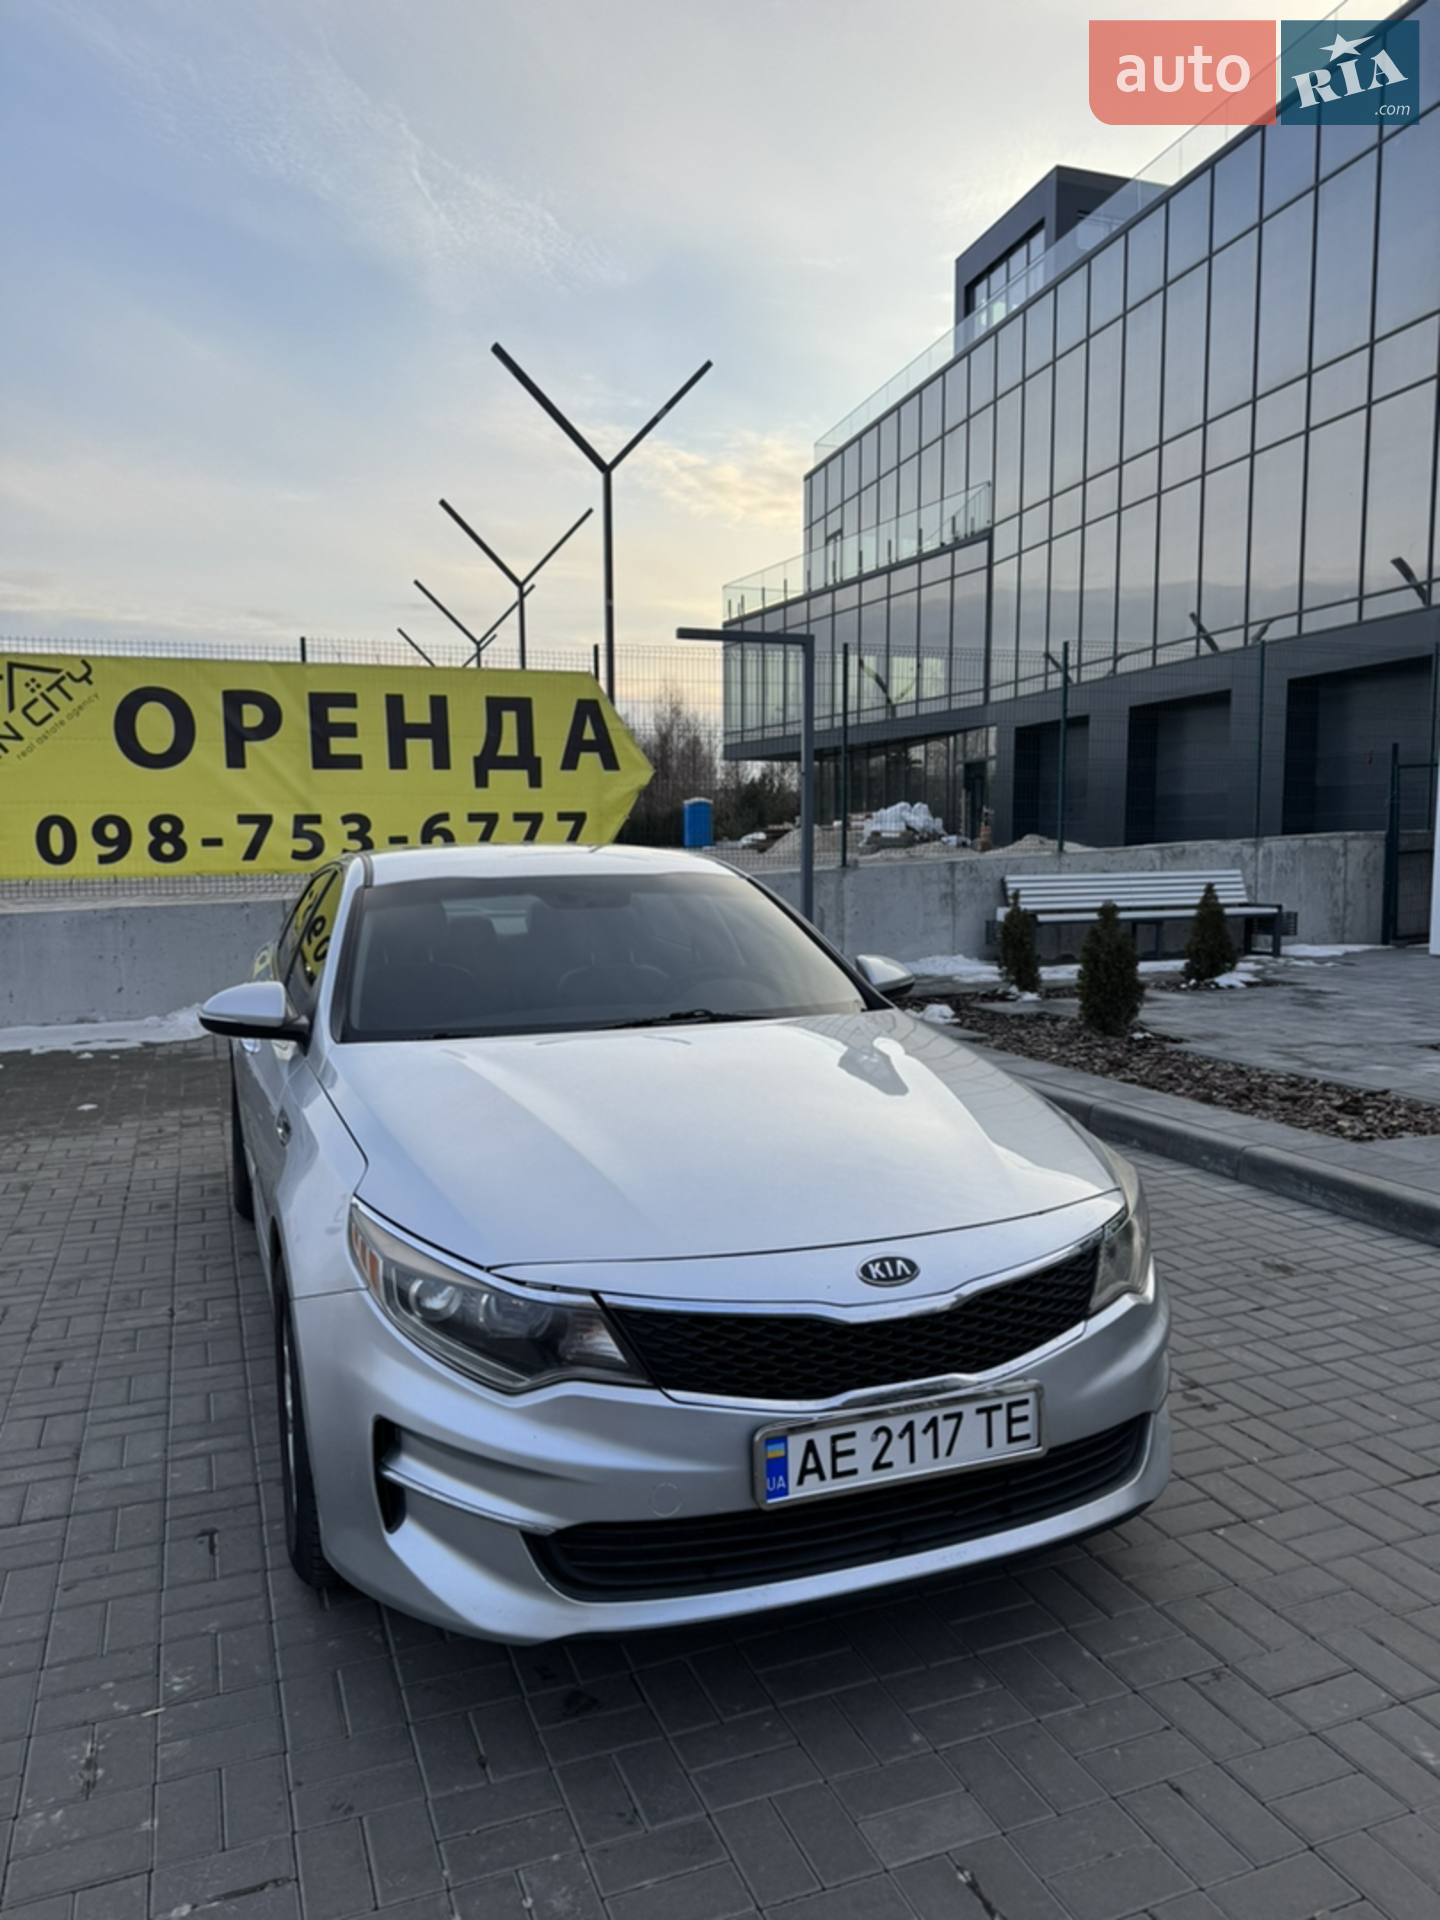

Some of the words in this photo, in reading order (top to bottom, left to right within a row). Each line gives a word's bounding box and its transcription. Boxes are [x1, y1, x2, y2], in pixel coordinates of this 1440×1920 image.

[21, 659, 93, 727] CITY
[66, 692, 100, 720] agency
[113, 686, 621, 789] ОРЕНДА
[35, 811, 588, 866] 098-753-6777
[867, 1259, 912, 1279] KIA
[796, 1431, 858, 1486] AE
[871, 1412, 964, 1472] 2117
[975, 1398, 1031, 1449] TE
[767, 1475, 787, 1491] UA
